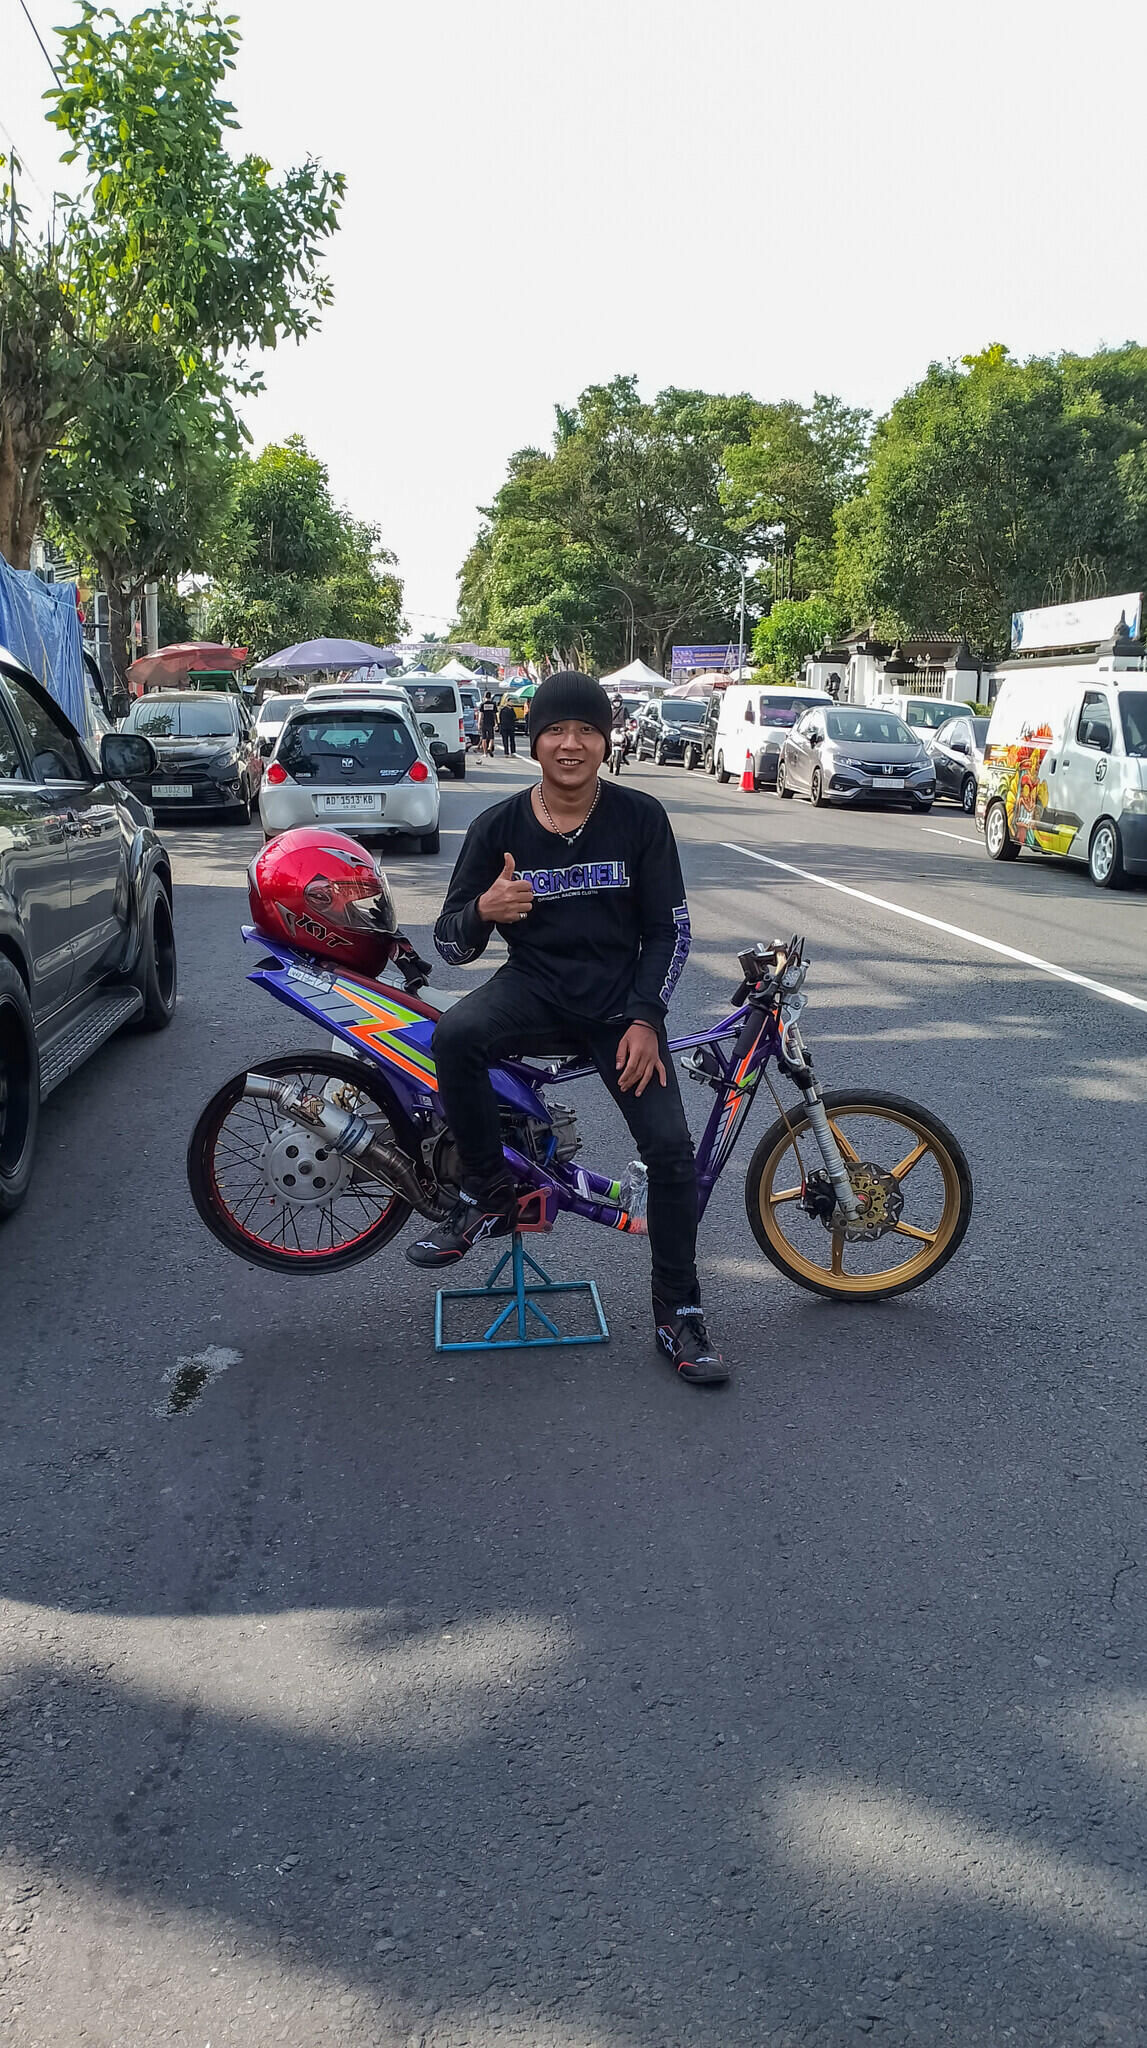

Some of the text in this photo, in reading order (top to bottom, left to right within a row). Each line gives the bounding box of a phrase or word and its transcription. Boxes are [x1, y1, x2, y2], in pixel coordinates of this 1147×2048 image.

[326, 795, 373, 805] AD 1513 KB
[537, 894, 560, 903] ORIGINAL
[561, 890, 581, 898] RACING
